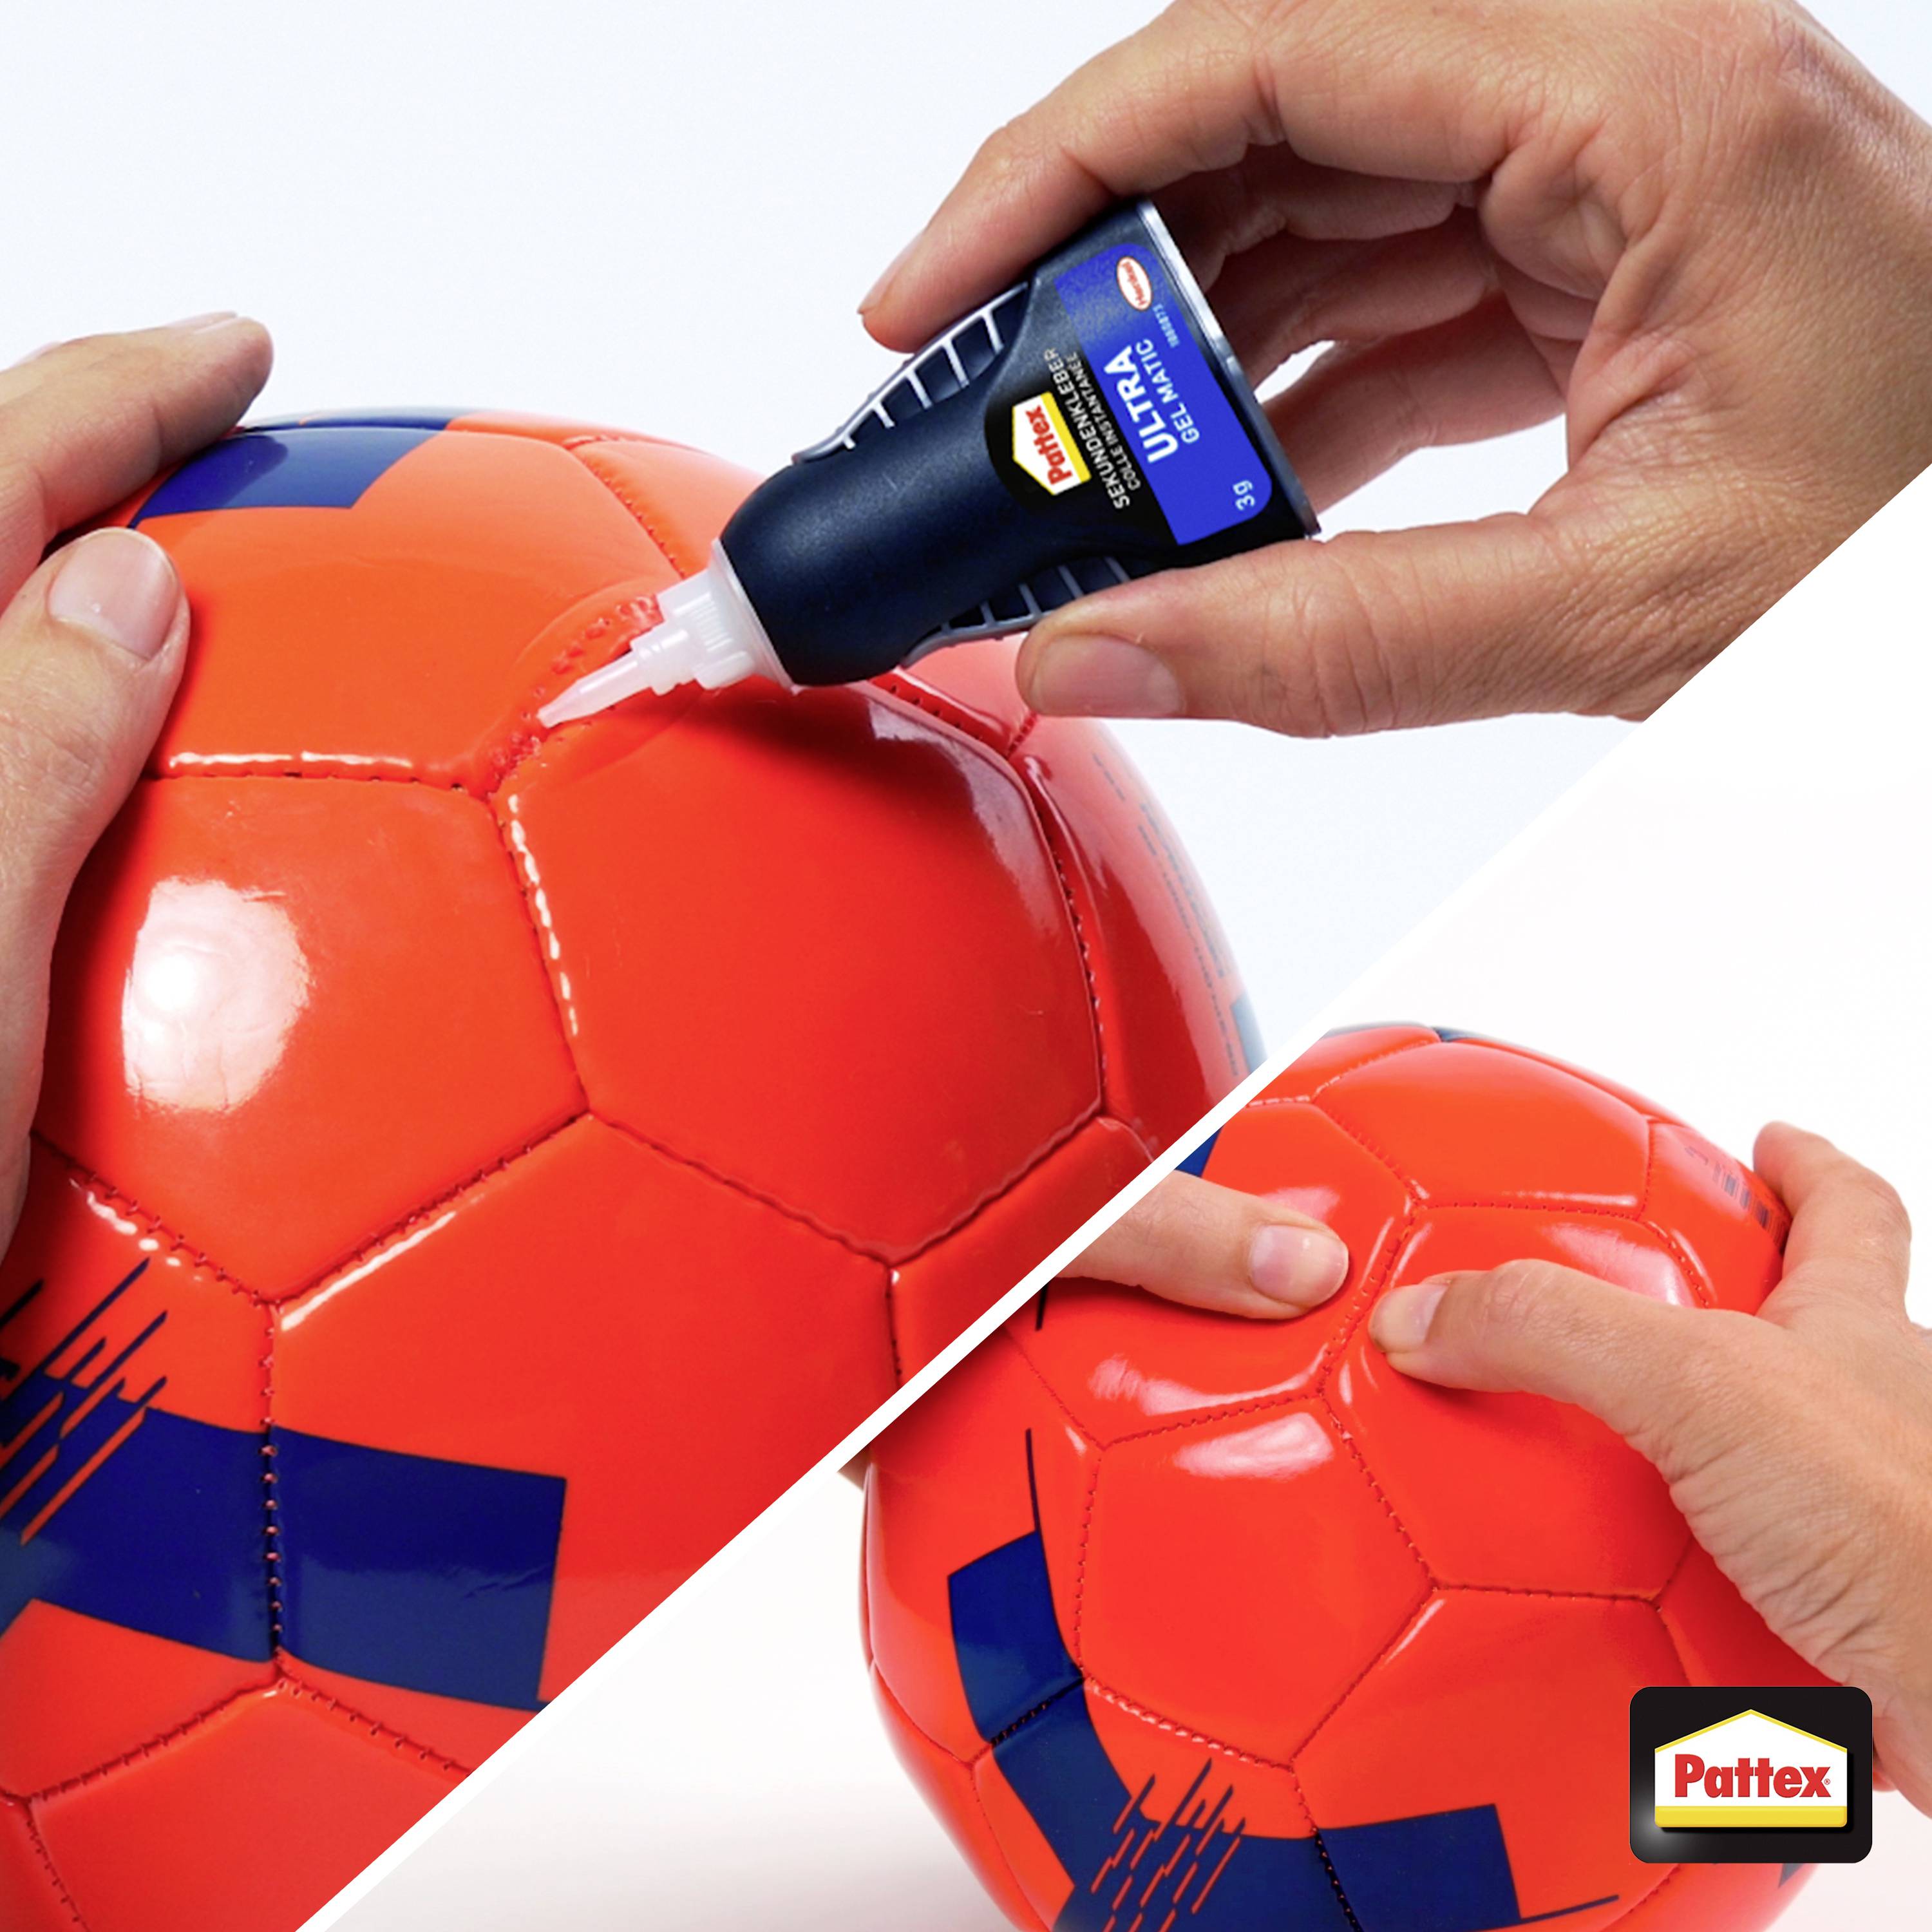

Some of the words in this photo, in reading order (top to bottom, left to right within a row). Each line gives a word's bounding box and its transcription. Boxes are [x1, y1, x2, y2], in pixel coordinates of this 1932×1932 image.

[1122, 261, 1147, 305] Henkel
[1135, 339, 1179, 403] MATIC
[1044, 348, 1130, 509] SEKUNDENKLEBER
[1103, 346, 1179, 464] ULTRA
[1170, 404, 1200, 444] GEL
[1025, 406, 1073, 485] Pattex
[1111, 445, 1141, 490] COLLE
[1233, 480, 1255, 510] 3g
